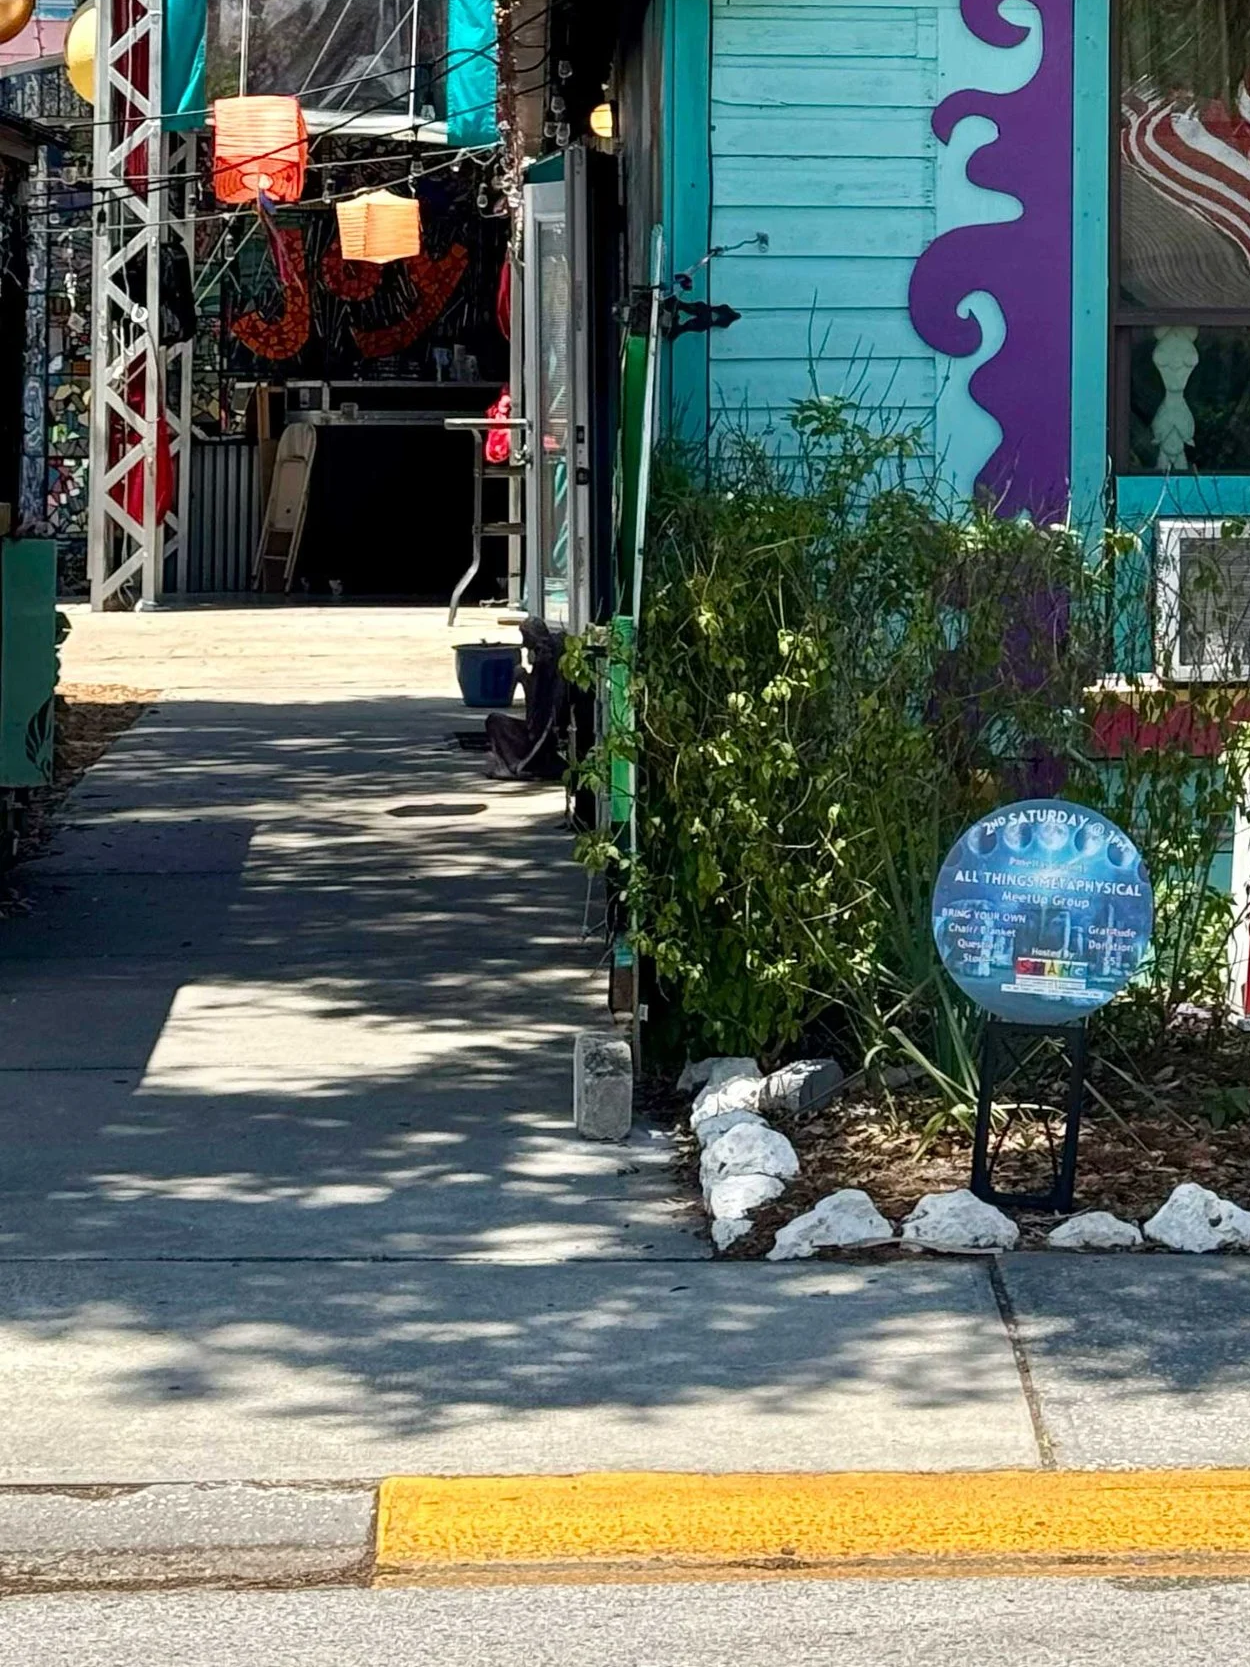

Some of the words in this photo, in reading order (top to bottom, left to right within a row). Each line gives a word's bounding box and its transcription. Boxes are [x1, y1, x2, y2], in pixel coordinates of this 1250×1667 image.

[982, 816, 1006, 836] 2ND
[1008, 808, 1089, 830] SATURDAY
[1090, 821, 1105, 836] @
[954, 869, 979, 884] ALL
[983, 871, 1035, 888] THINGS
[1037, 876, 1142, 897] METAPHYSICAL
[1001, 890, 1048, 908] MeetUp
[1052, 894, 1090, 910] Group
[941, 907, 972, 920] BRING
[974, 910, 1000, 922] YOUR
[1002, 913, 1027, 924] OWN
[1087, 925, 1137, 939] Gratitude
[1088, 940, 1134, 953] Donation
